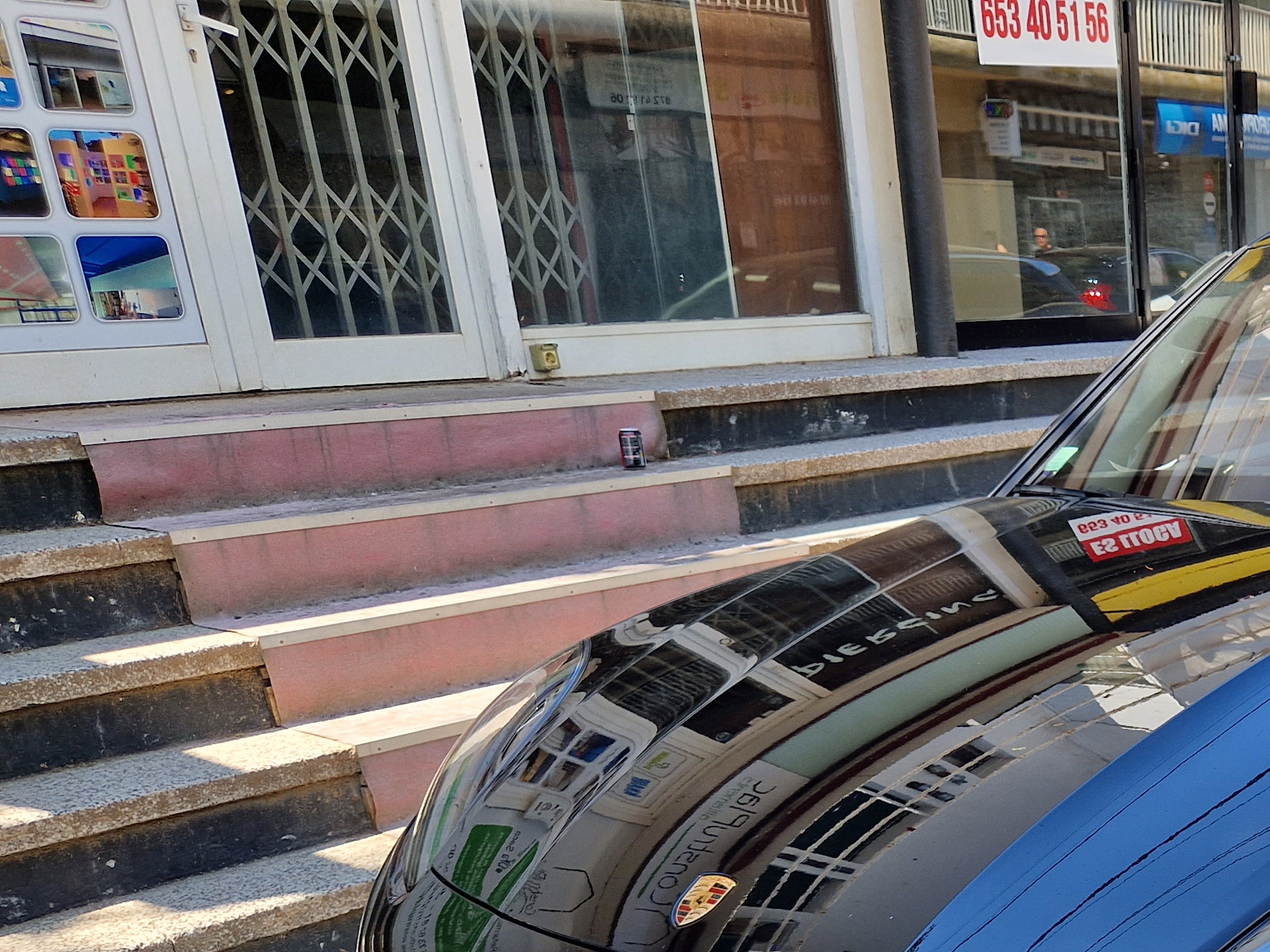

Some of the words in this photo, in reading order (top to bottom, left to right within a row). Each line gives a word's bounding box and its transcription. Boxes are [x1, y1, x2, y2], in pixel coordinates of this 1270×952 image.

[981, 0, 1022, 39] 653
[1027, 0, 1052, 40] 40
[1056, 0, 1080, 42] 51
[1084, 1, 1109, 43] 56
